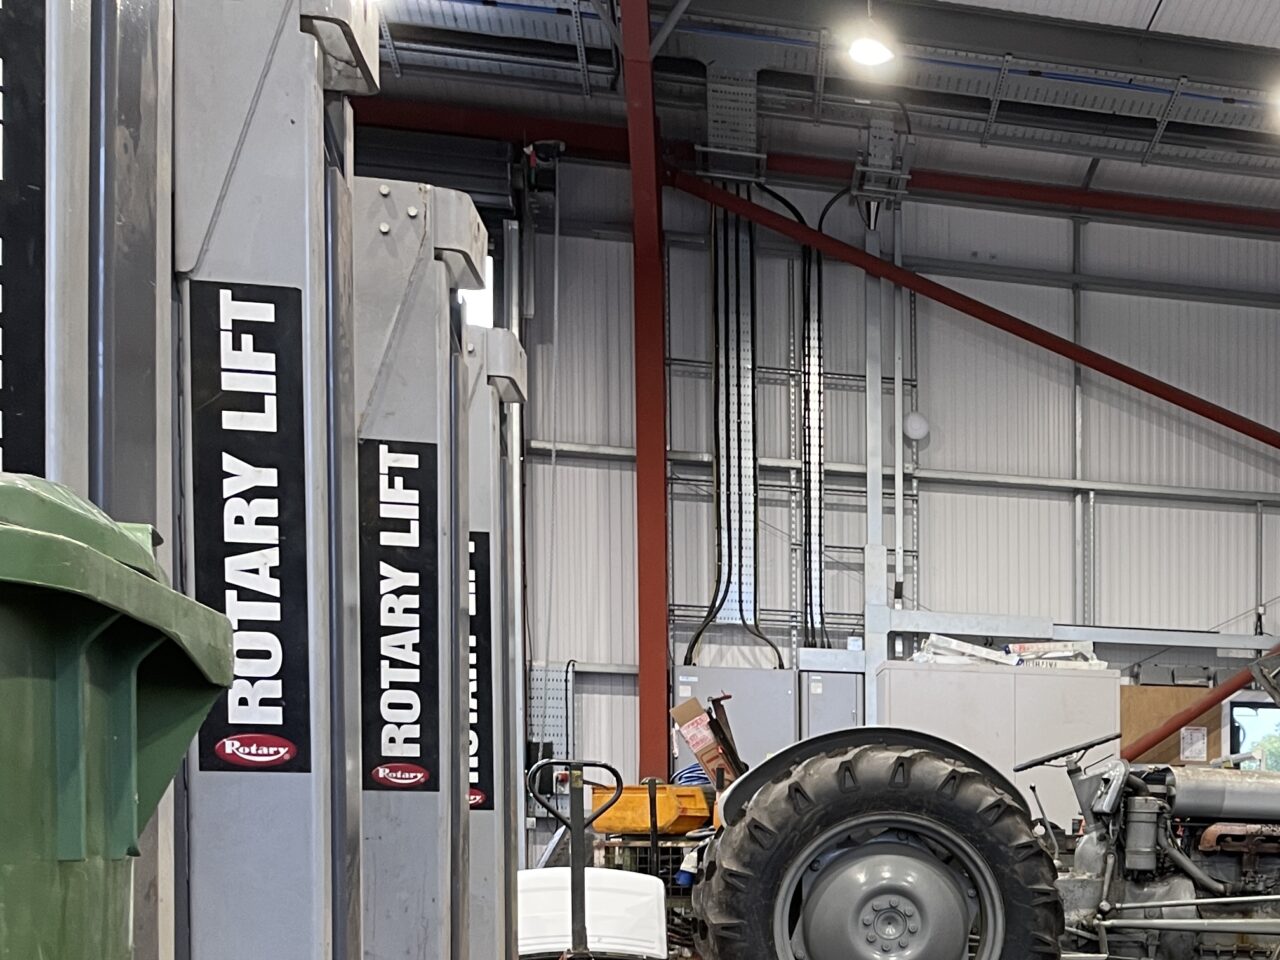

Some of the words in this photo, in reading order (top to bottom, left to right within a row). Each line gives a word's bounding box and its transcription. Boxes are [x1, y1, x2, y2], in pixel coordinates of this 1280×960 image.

[220, 289, 278, 433] LIFT
[379, 444, 421, 548] LIFT
[222, 452, 284, 725] ROTARY
[380, 561, 422, 757] ROTARY
[223, 738, 289, 762] Rotary
[377, 767, 424, 784] Rotary
